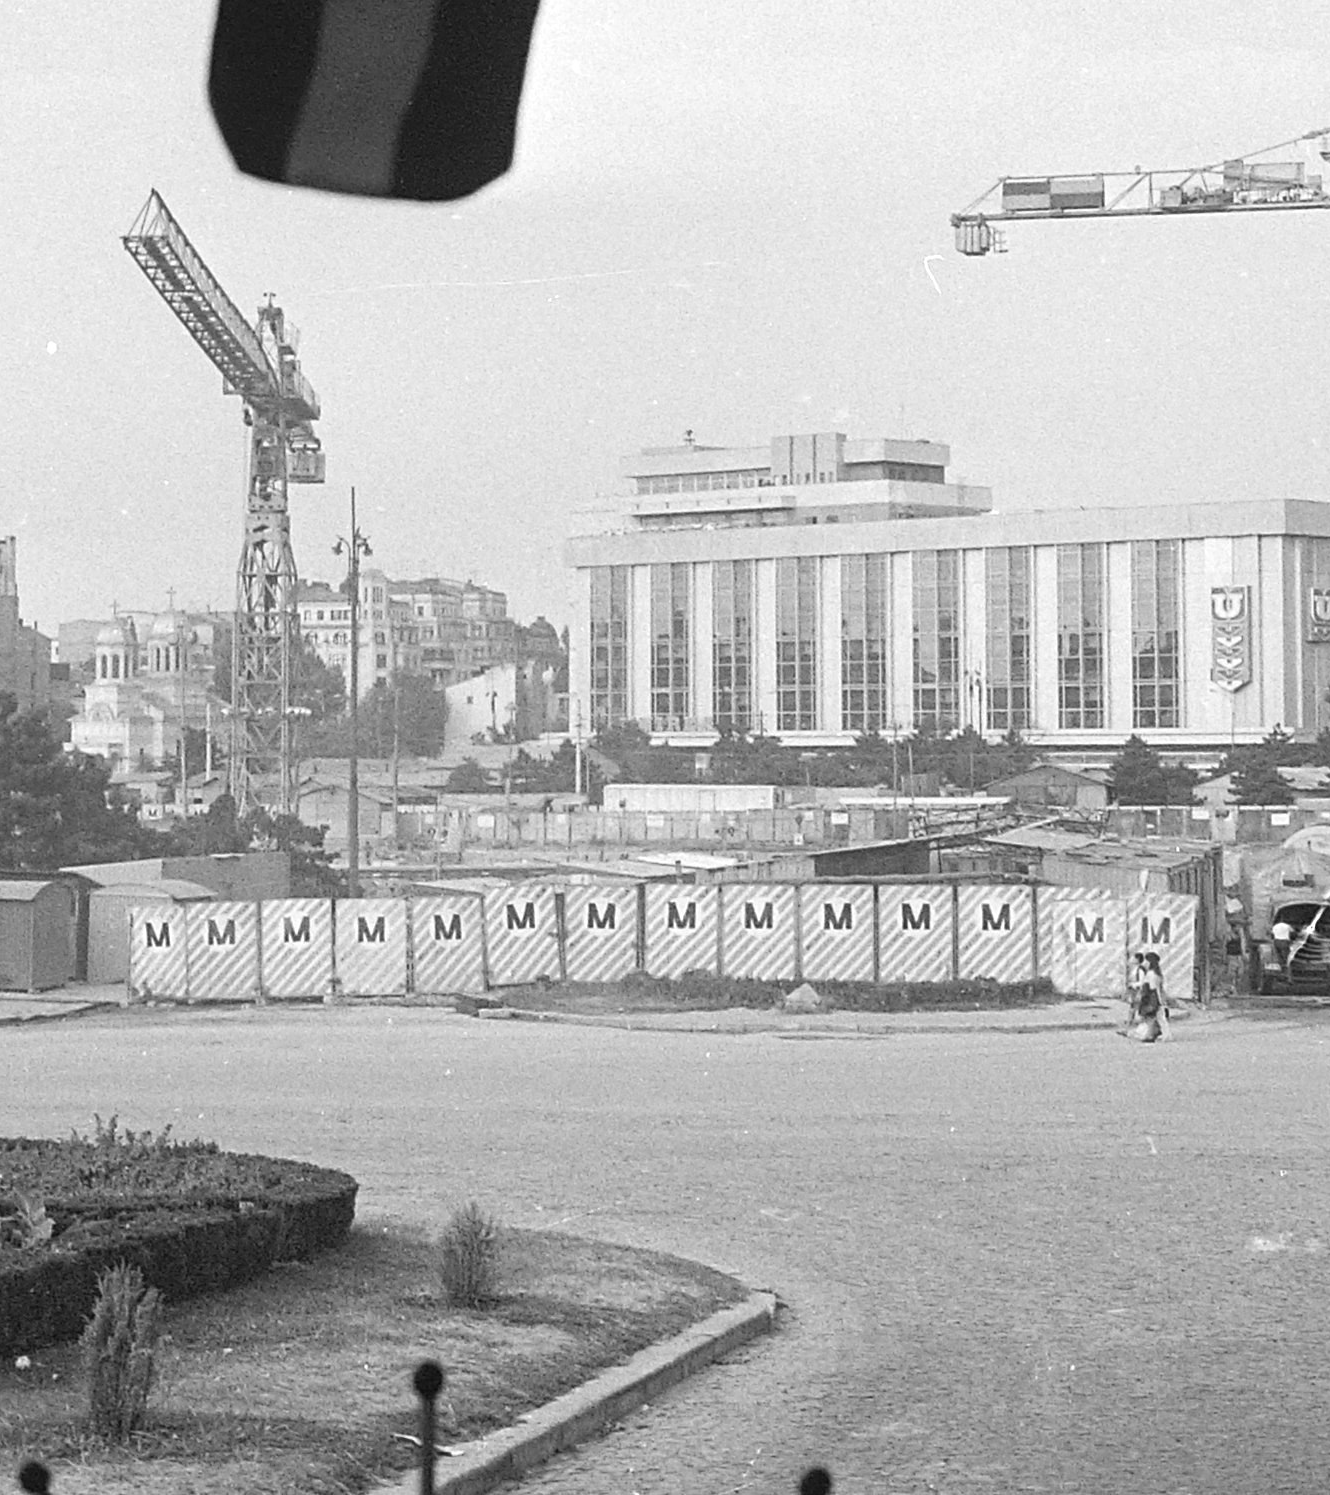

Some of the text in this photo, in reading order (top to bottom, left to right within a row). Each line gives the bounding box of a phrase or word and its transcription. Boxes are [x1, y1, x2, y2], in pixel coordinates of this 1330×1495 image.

[433, 914, 463, 940] M
[506, 902, 536, 930] M
[587, 903, 616, 929] M
[667, 902, 696, 929] M
[744, 903, 773, 929] M
[823, 903, 853, 930] M
[901, 903, 931, 930] M
[981, 903, 1011, 931] M
[145, 922, 170, 947] M
[207, 920, 236, 945] M
[283, 916, 311, 943] M
[357, 917, 386, 943] M
[1074, 917, 1104, 943] M
[1141, 917, 1171, 944] M
